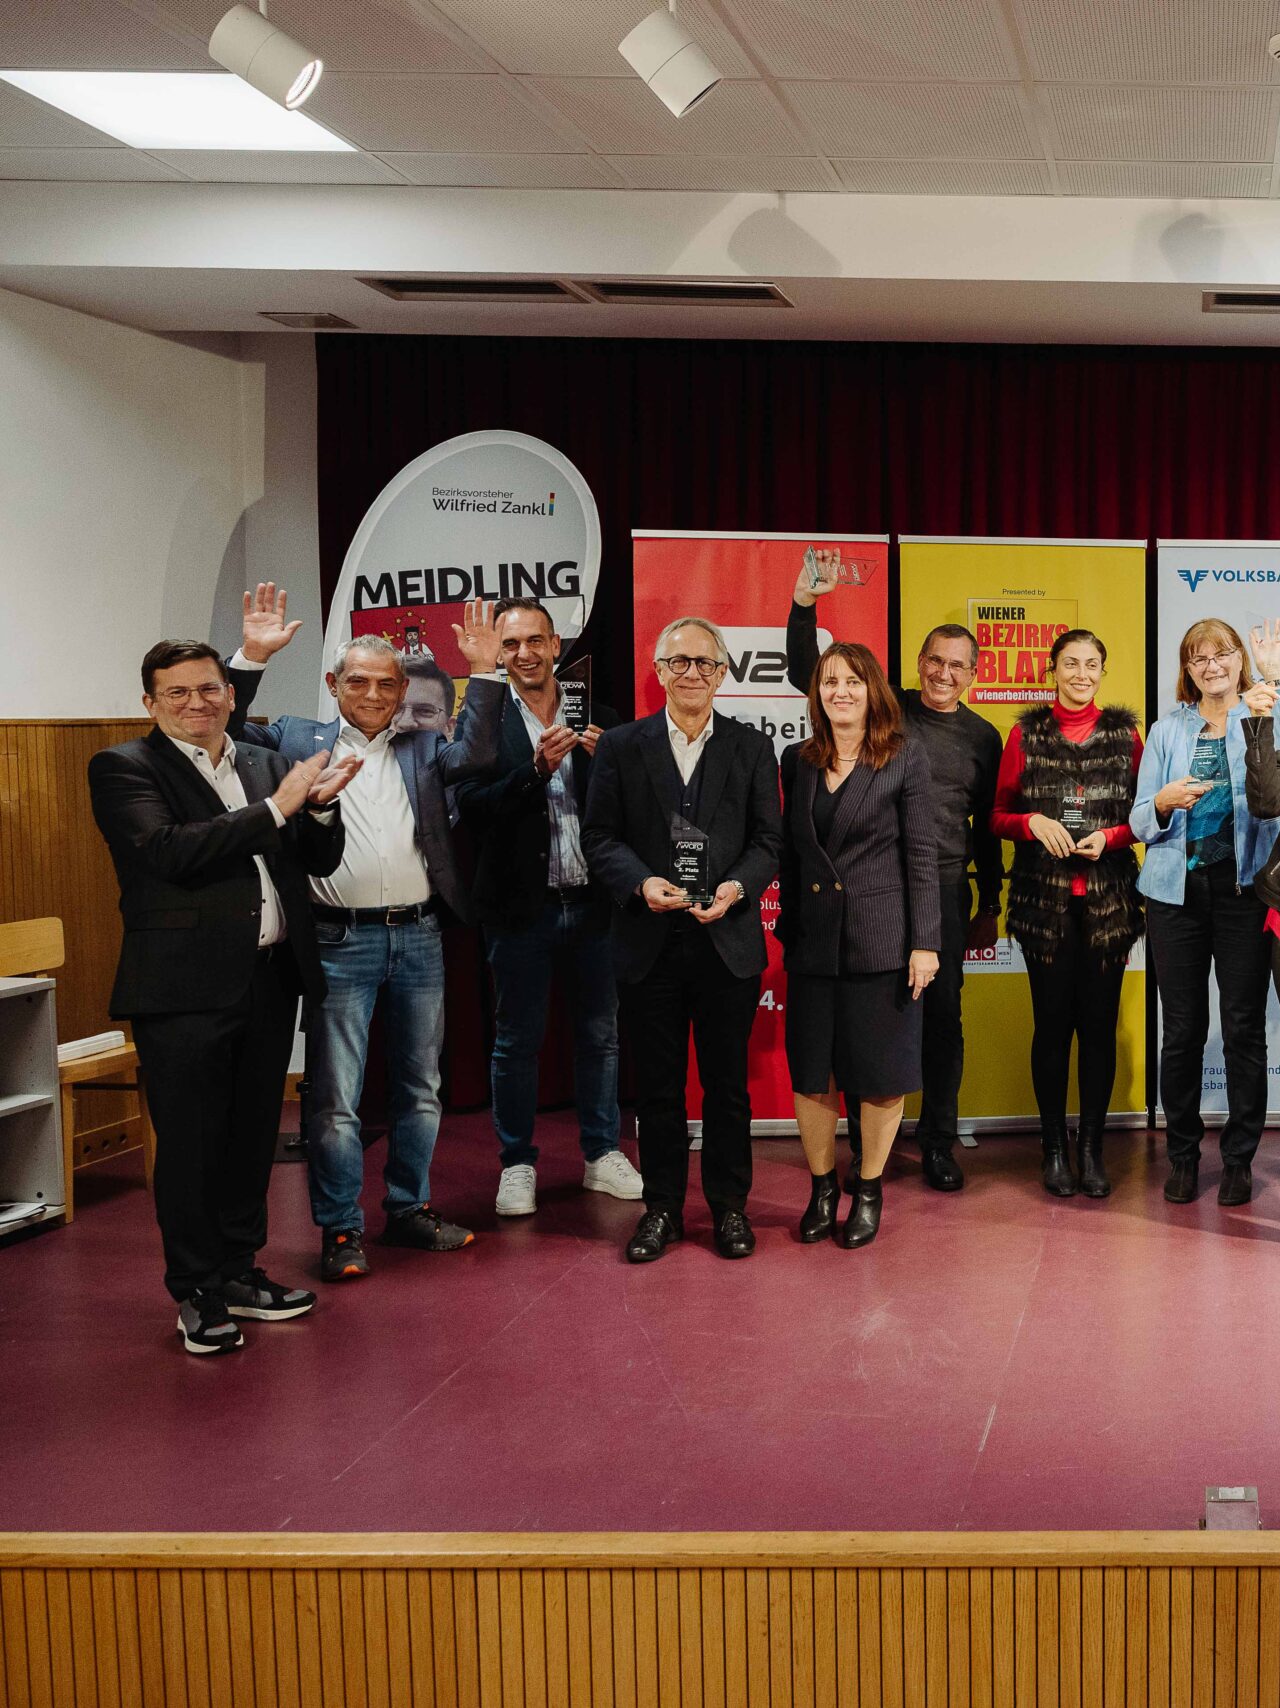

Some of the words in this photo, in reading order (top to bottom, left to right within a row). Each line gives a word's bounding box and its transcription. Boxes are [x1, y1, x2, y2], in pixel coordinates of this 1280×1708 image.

[432, 487, 514, 499] Bezirksvorsteher
[433, 498, 498, 514] Wilfried
[501, 501, 546, 516] Zankl
[353, 560, 580, 610] MEIDLING
[1002, 588, 1036, 596] Presented
[977, 606, 1025, 621] WIENER
[976, 623, 1069, 648] BEZIRKS
[976, 650, 1052, 684] BLAT
